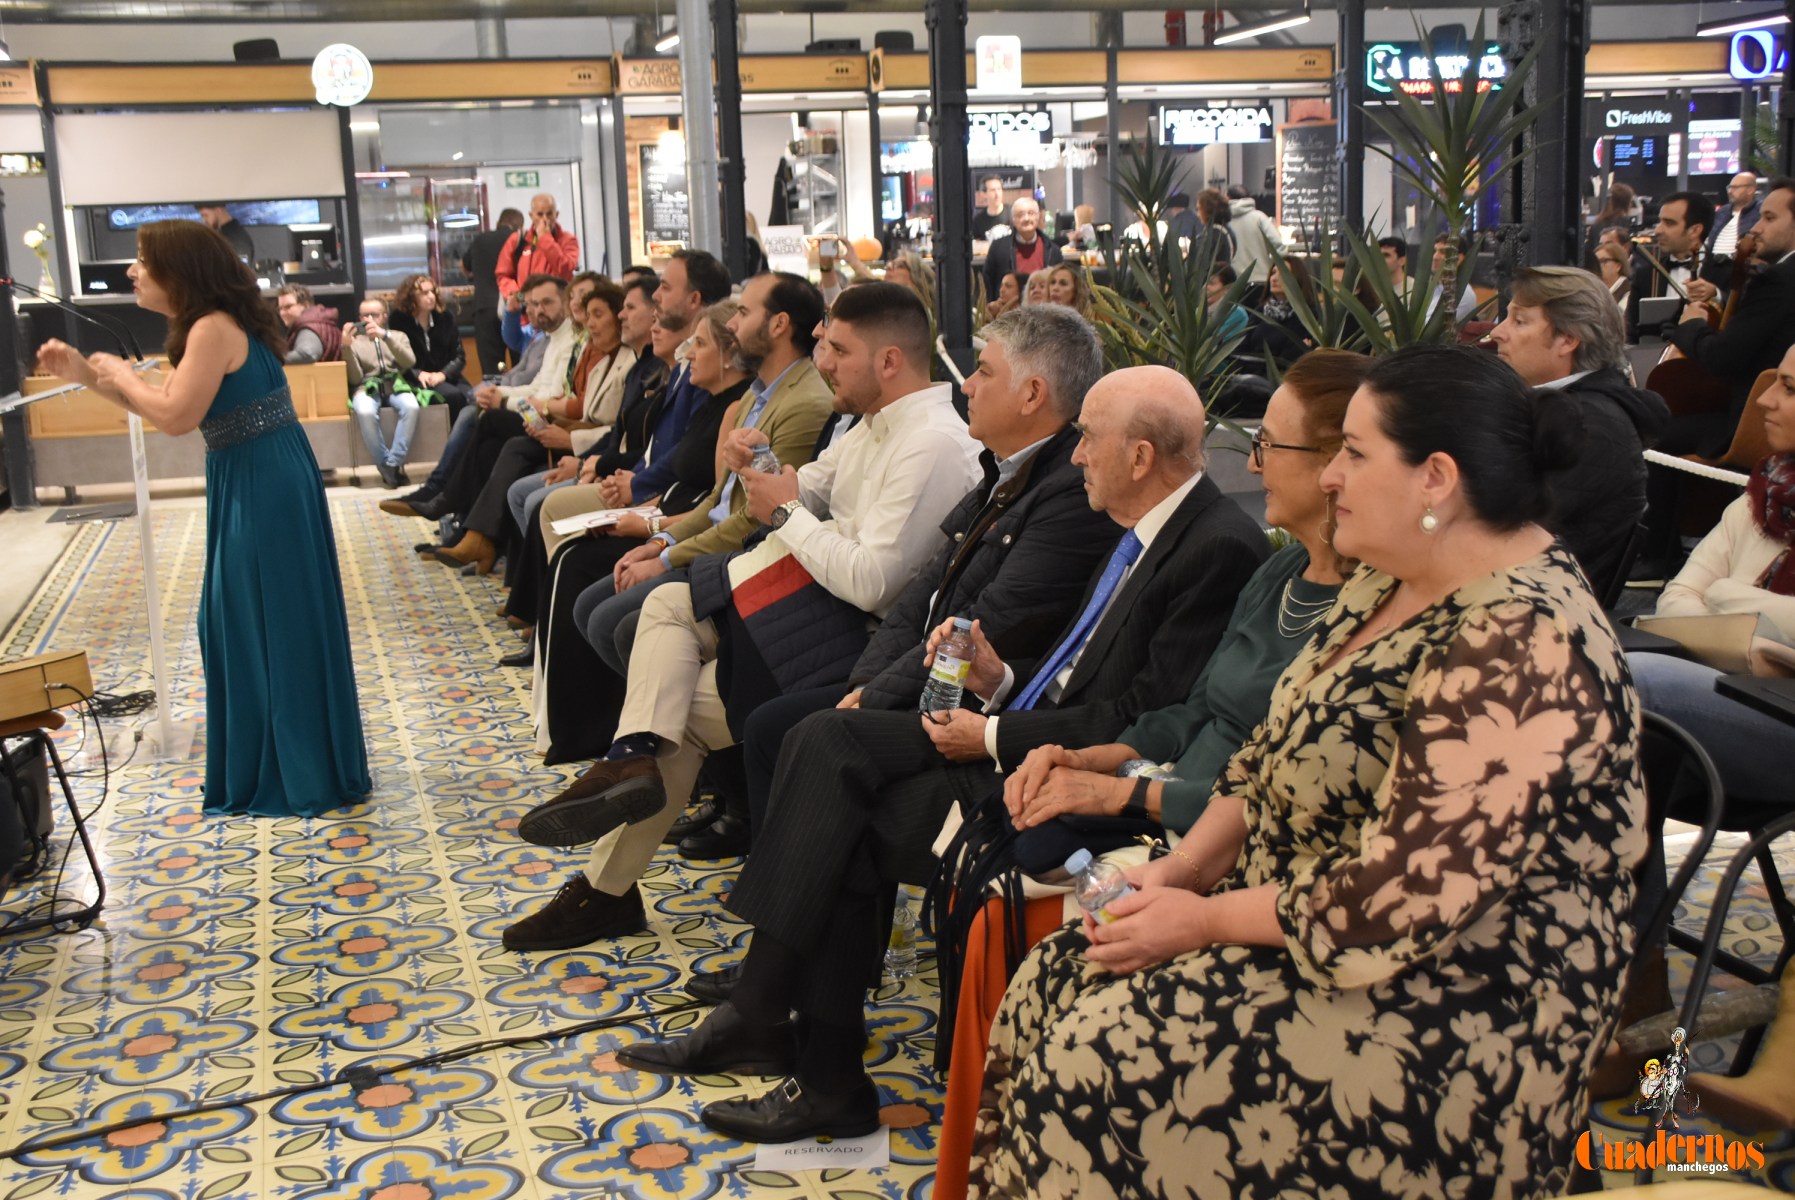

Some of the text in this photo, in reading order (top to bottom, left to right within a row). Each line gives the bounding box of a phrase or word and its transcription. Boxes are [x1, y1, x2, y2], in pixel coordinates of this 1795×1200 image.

[1165, 107, 1272, 129] RECOGIDA
[1621, 109, 1673, 125] FreshVibe
[784, 1146, 864, 1156] RESERVADO
